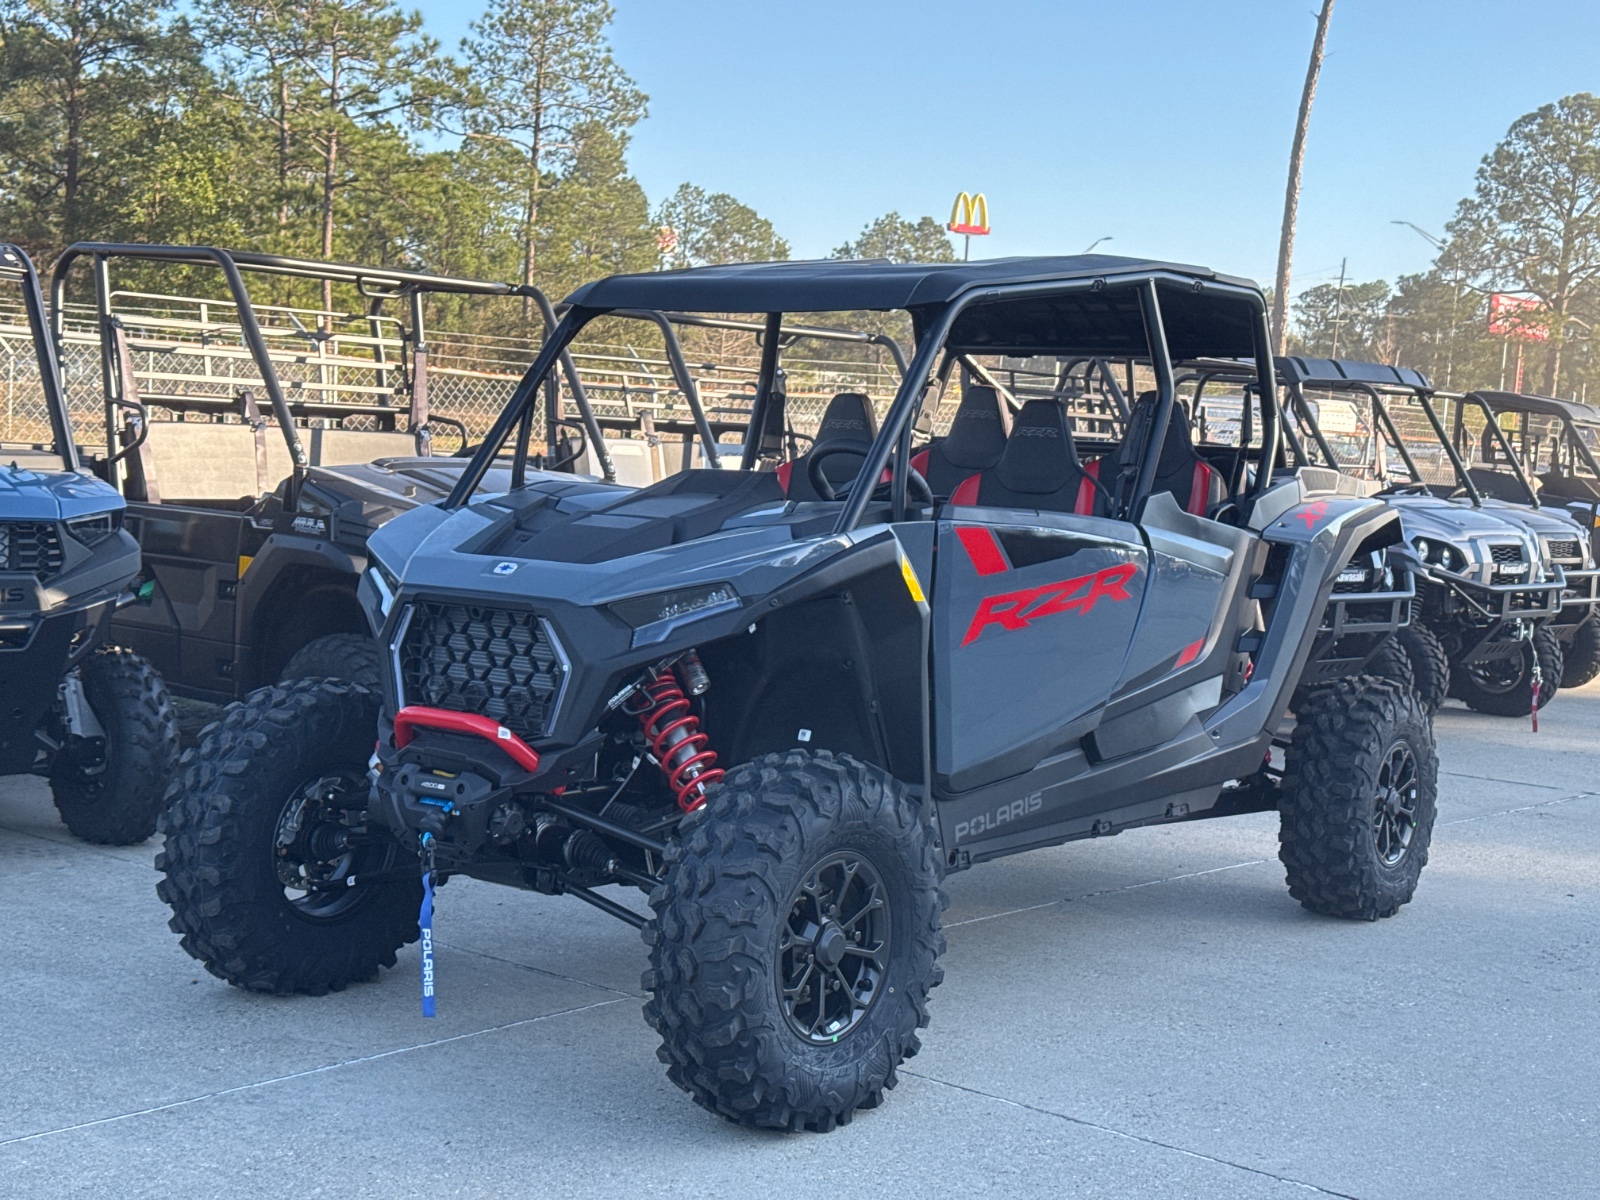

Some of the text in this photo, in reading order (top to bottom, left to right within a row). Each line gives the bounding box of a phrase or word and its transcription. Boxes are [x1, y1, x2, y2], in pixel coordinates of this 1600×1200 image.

[1014, 426, 1058, 438] RZR
[960, 562, 1138, 648] RZR
[954, 791, 1043, 843] POLARIS
[422, 928, 434, 997] POLARIS
